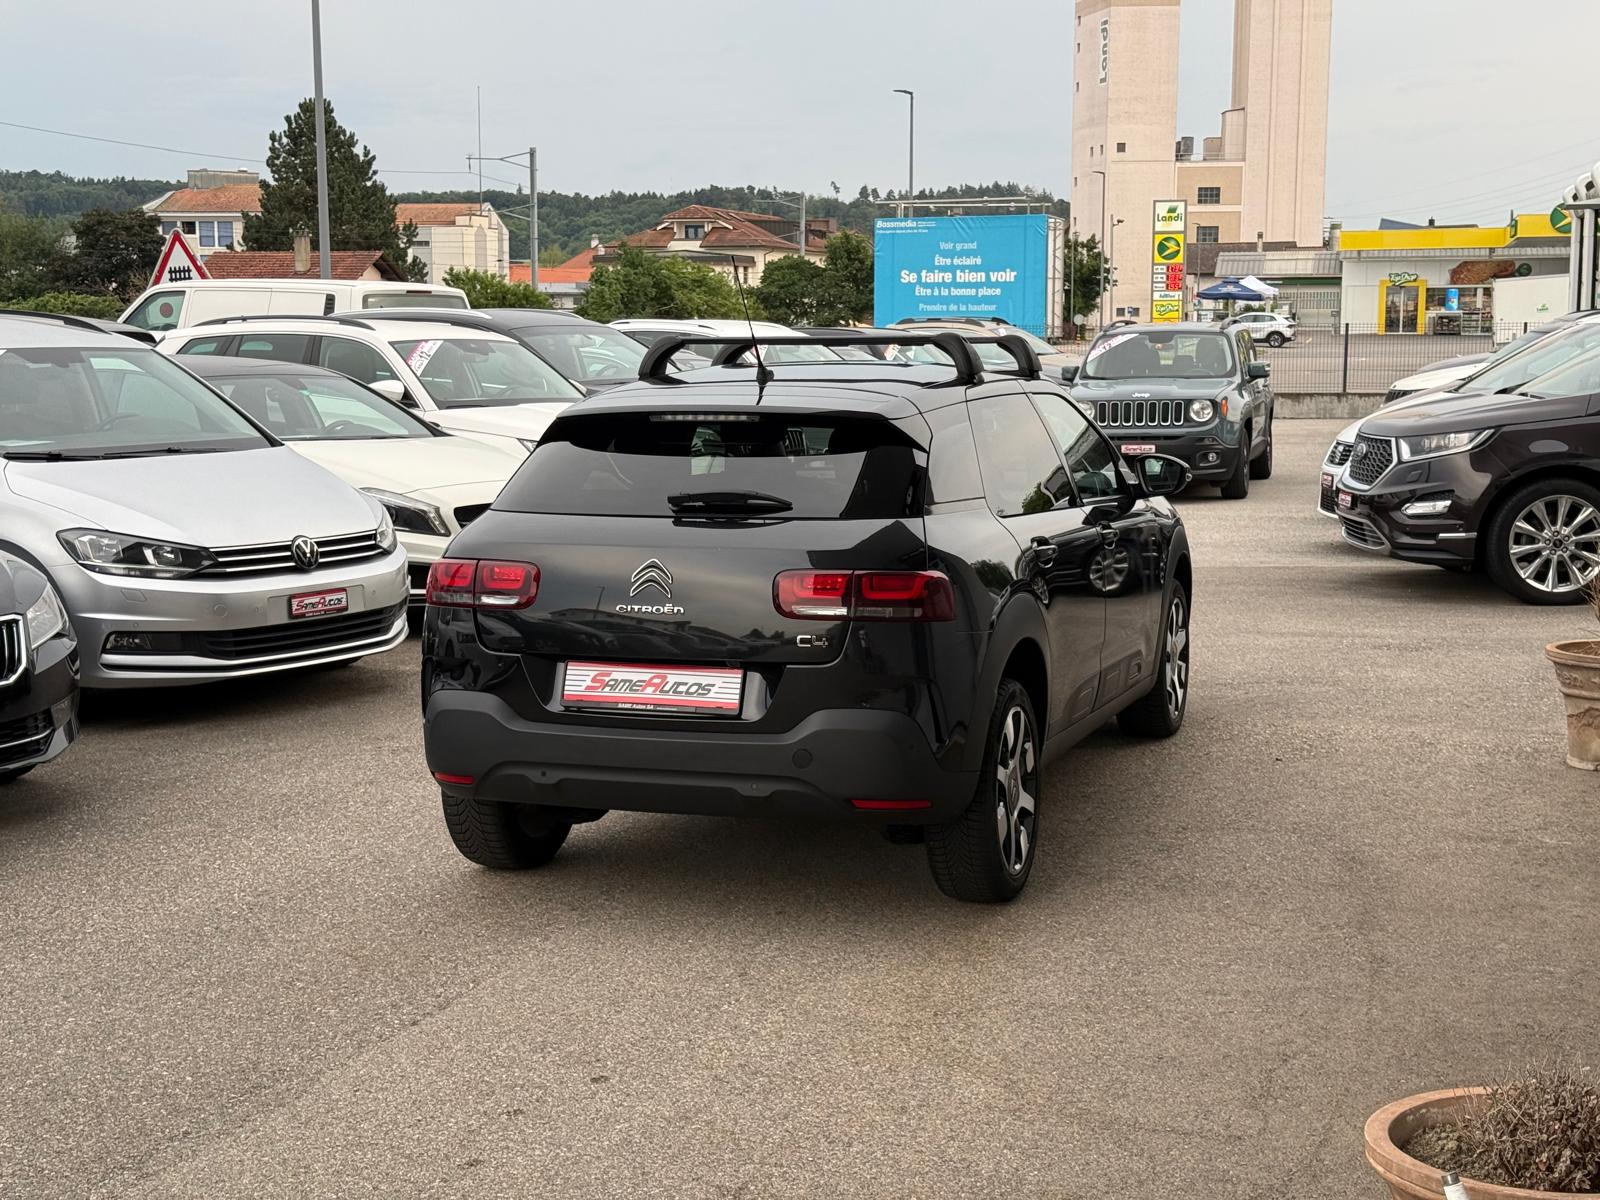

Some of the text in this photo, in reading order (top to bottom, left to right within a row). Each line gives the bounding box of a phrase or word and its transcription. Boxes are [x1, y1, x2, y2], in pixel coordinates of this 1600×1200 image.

[1100, 19, 1109, 84] Landi
[1157, 213, 1183, 222] Landi
[876, 220, 917, 228] Bossmedia
[939, 241, 977, 251] Voir grand
[935, 254, 982, 266] Être éclairé
[900, 269, 1017, 283] Se faire bien voir
[915, 285, 1001, 298] Être à la bonne place
[919, 303, 997, 312] Prendre de la hauteur
